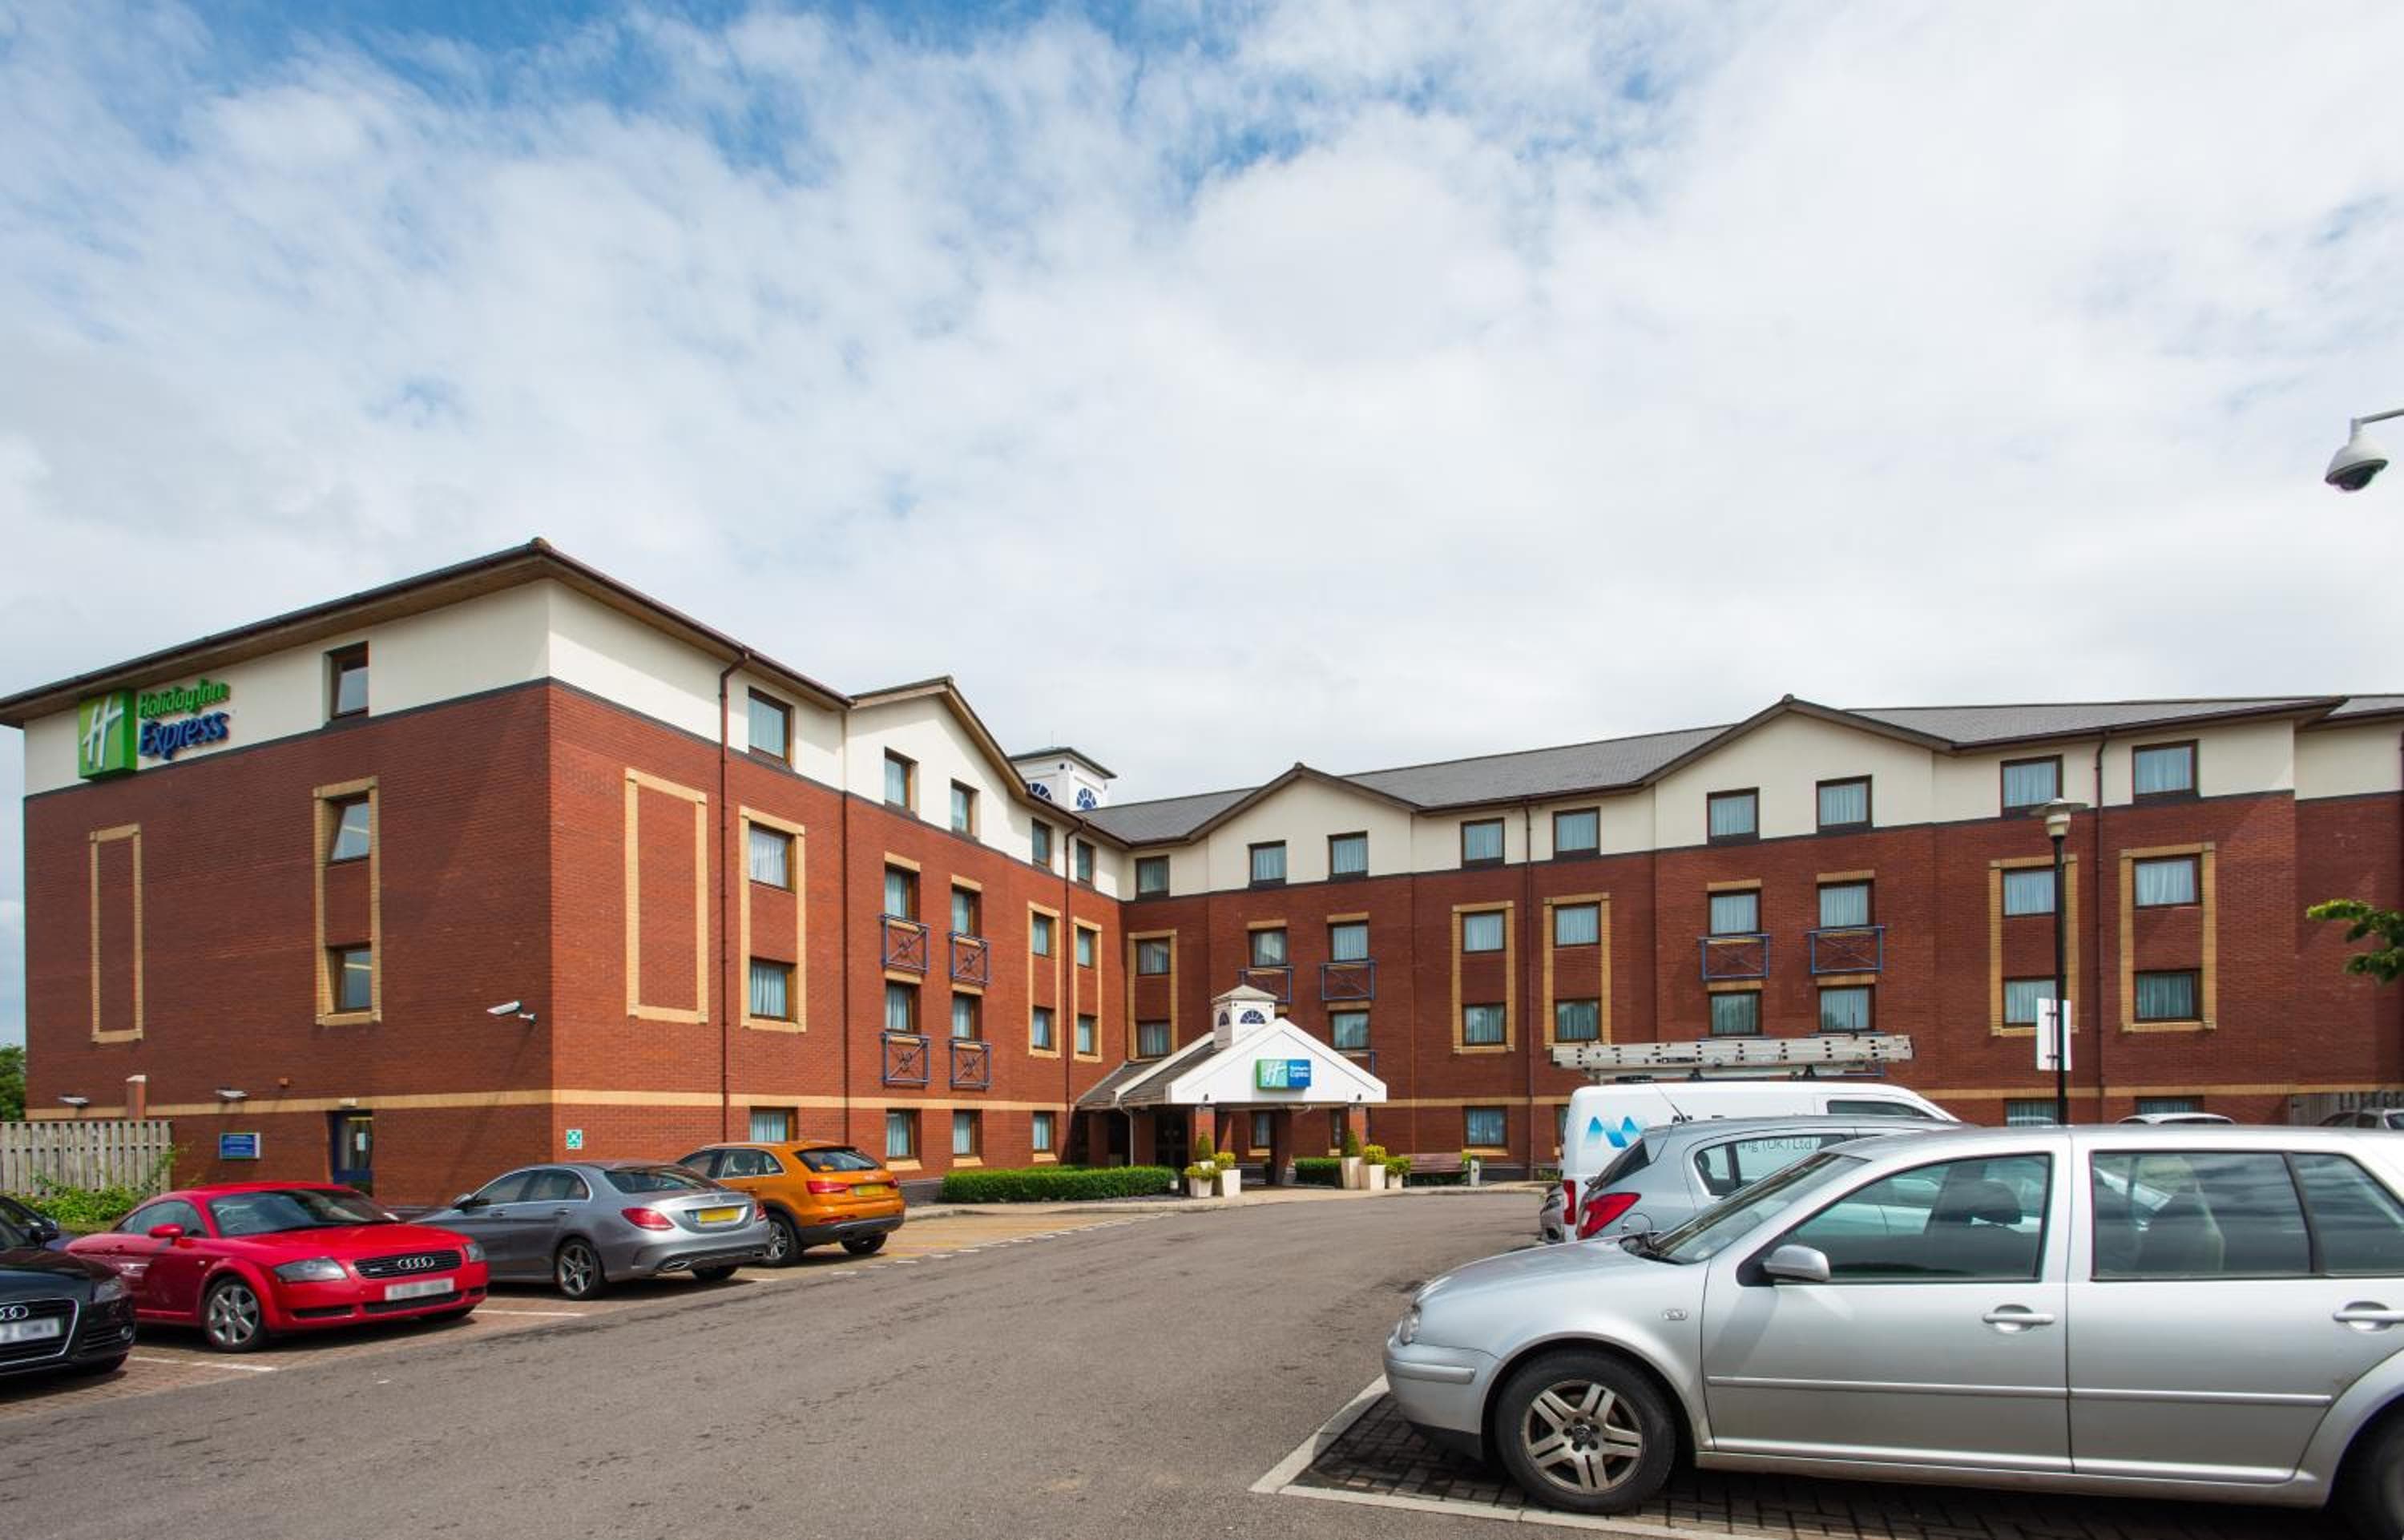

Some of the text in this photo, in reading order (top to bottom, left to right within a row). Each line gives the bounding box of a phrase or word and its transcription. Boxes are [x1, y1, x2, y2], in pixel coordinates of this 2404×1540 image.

[139, 677, 230, 718] Holiday Inn
[139, 712, 230, 760] Express
[1793, 1137, 1812, 1150] Ltd
